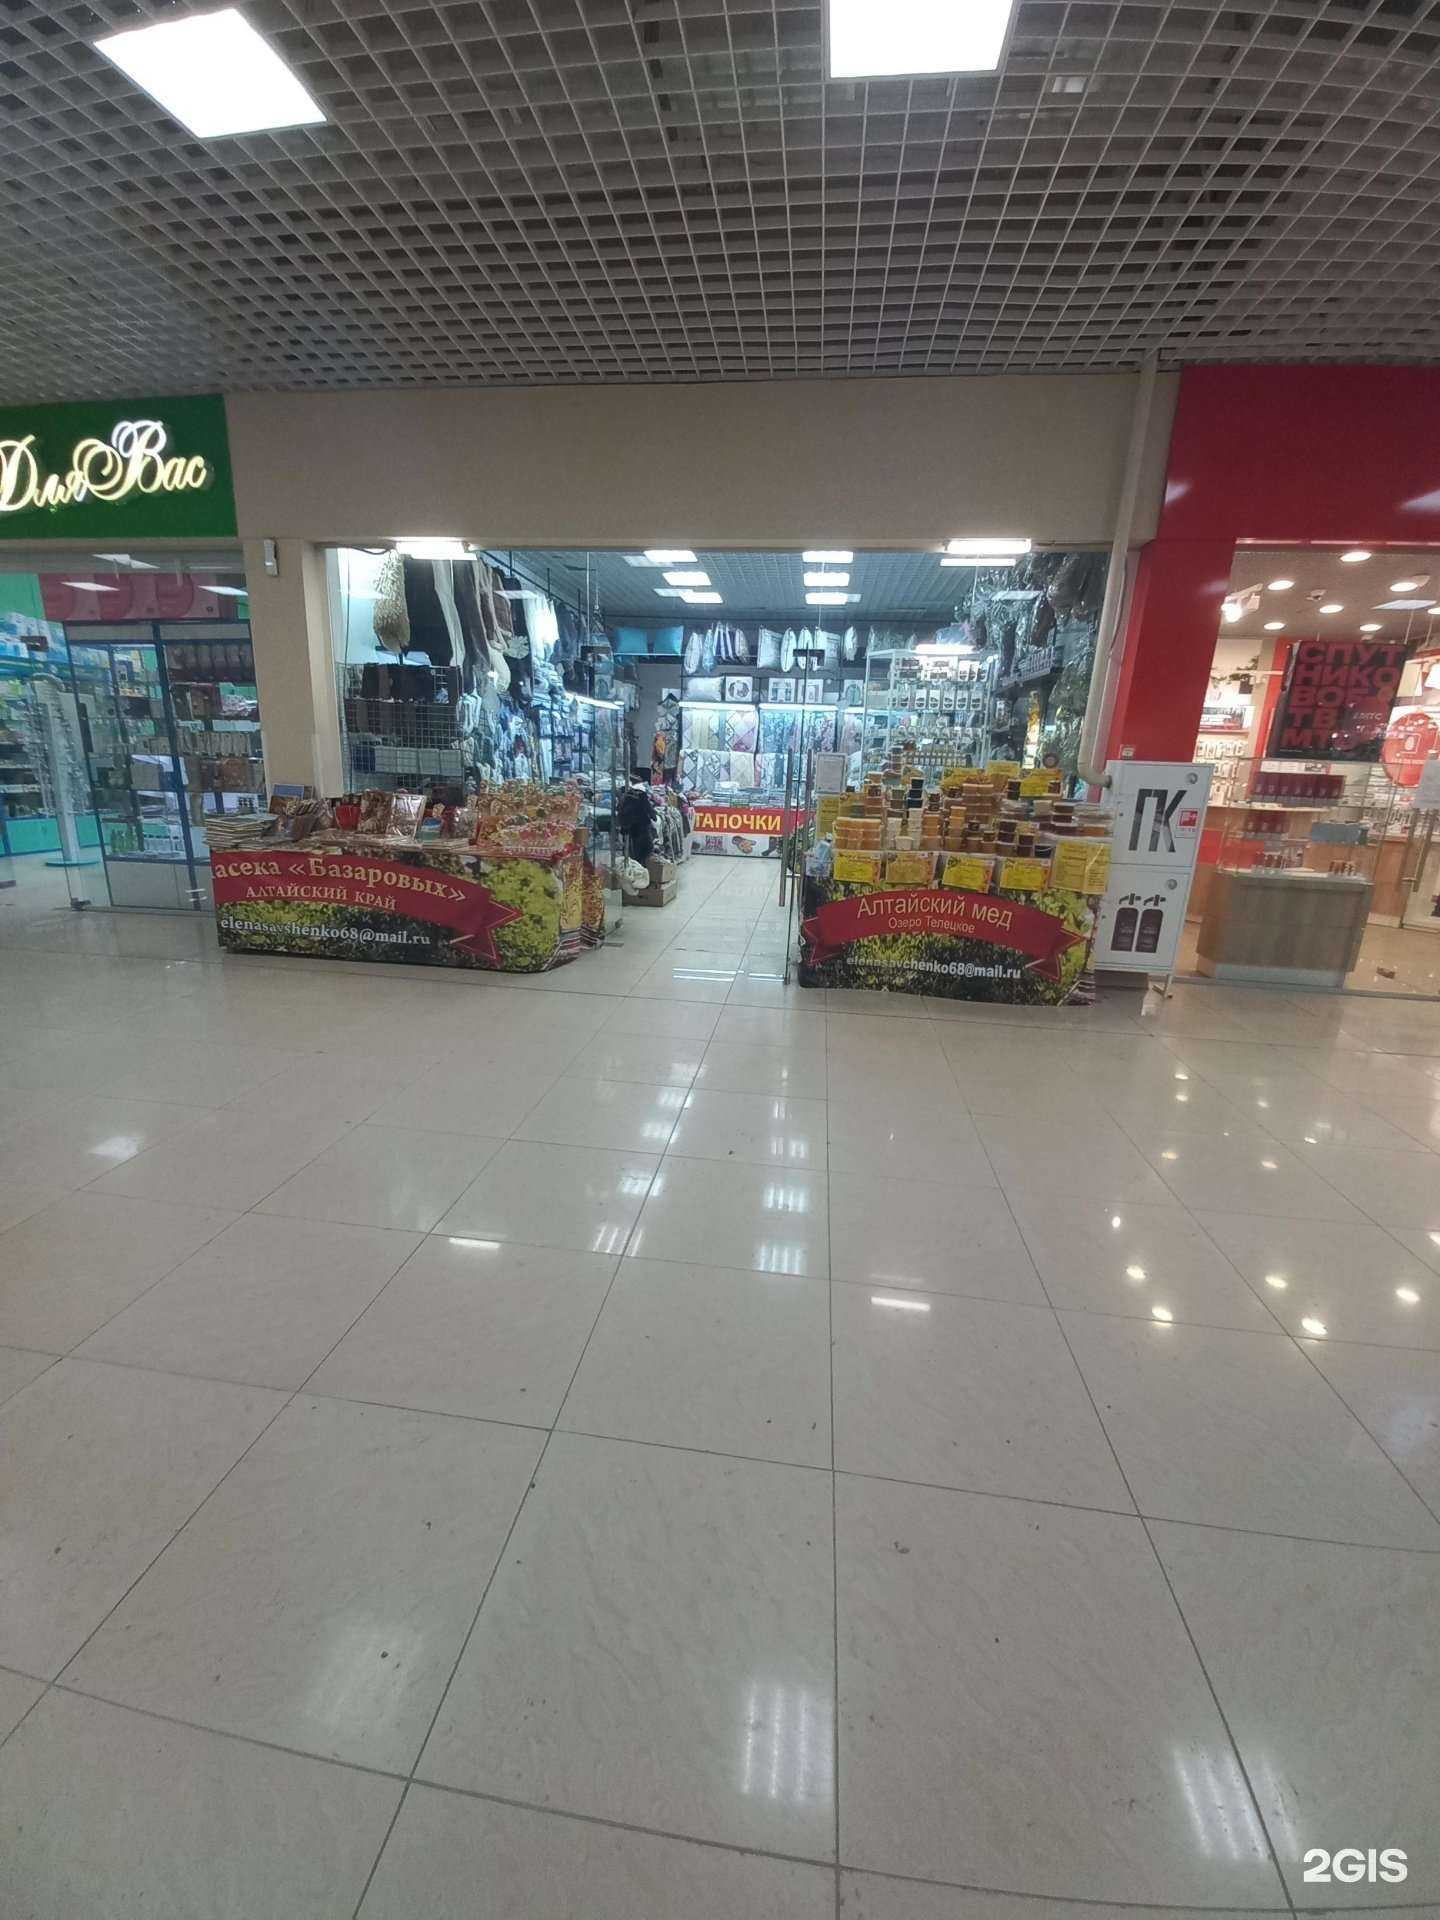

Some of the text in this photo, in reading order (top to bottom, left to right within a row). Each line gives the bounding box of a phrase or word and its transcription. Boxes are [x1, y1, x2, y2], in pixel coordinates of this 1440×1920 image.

[1302, 641, 1406, 665] СПУТ
[1296, 664, 1398, 688] НИКО
[695, 812, 781, 831] ТАПОЧКИ
[1128, 788, 1187, 853] ПК
[211, 857, 467, 902] асека «Базаровых»
[246, 884, 396, 911] АЛТАЙСКИЙ КРАЙ
[857, 893, 1014, 931] Алтайский мед
[888, 916, 976, 934] Озеро Телецкое
